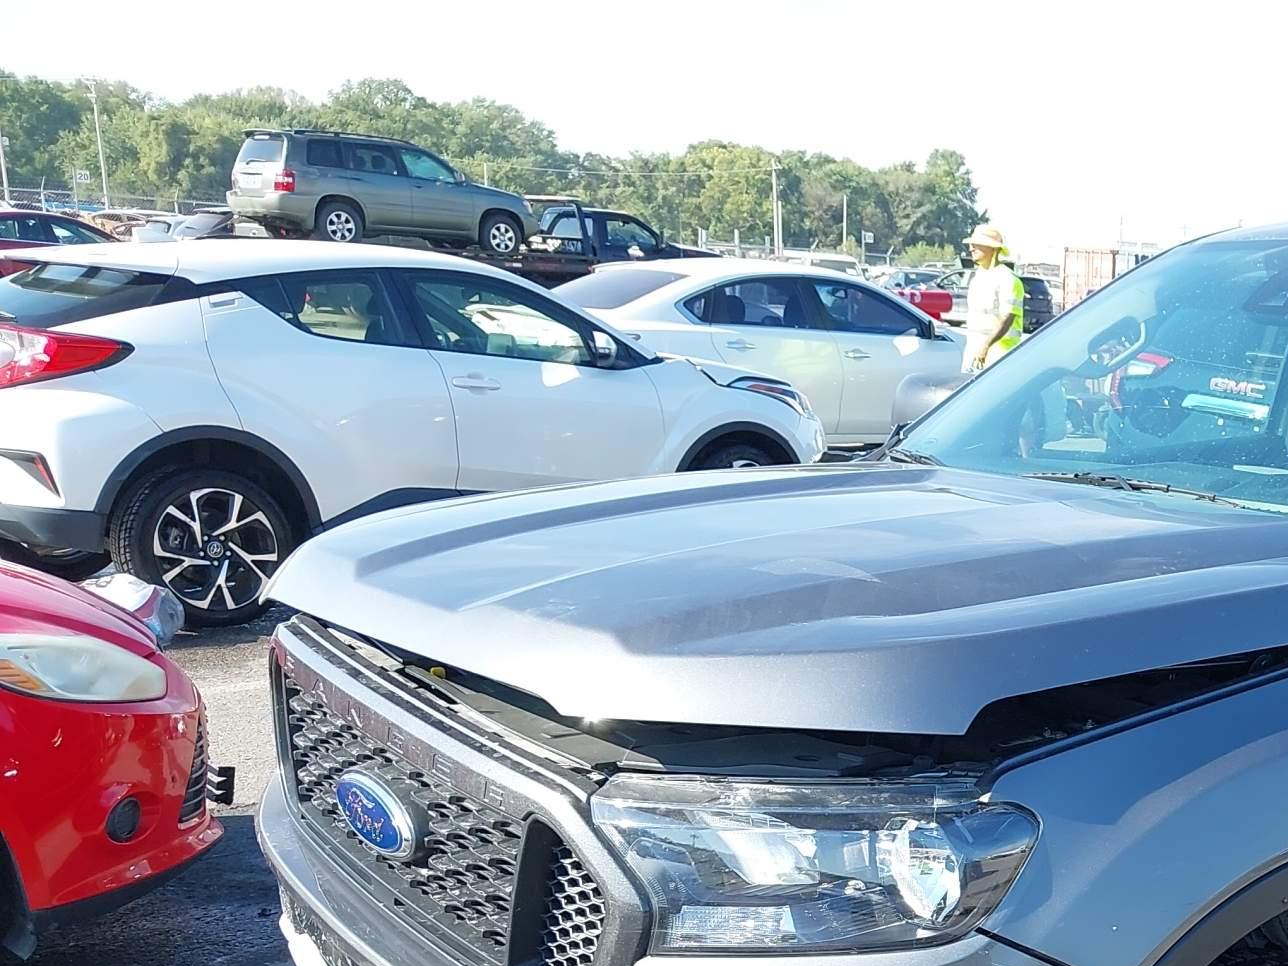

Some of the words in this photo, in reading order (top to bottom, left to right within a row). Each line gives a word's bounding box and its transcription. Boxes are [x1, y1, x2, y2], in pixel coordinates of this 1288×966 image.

[77, 172, 89, 181] 20
[1209, 376, 1267, 399] GMC
[284, 654, 506, 809] RANGER
[345, 787, 385, 842] Ford
